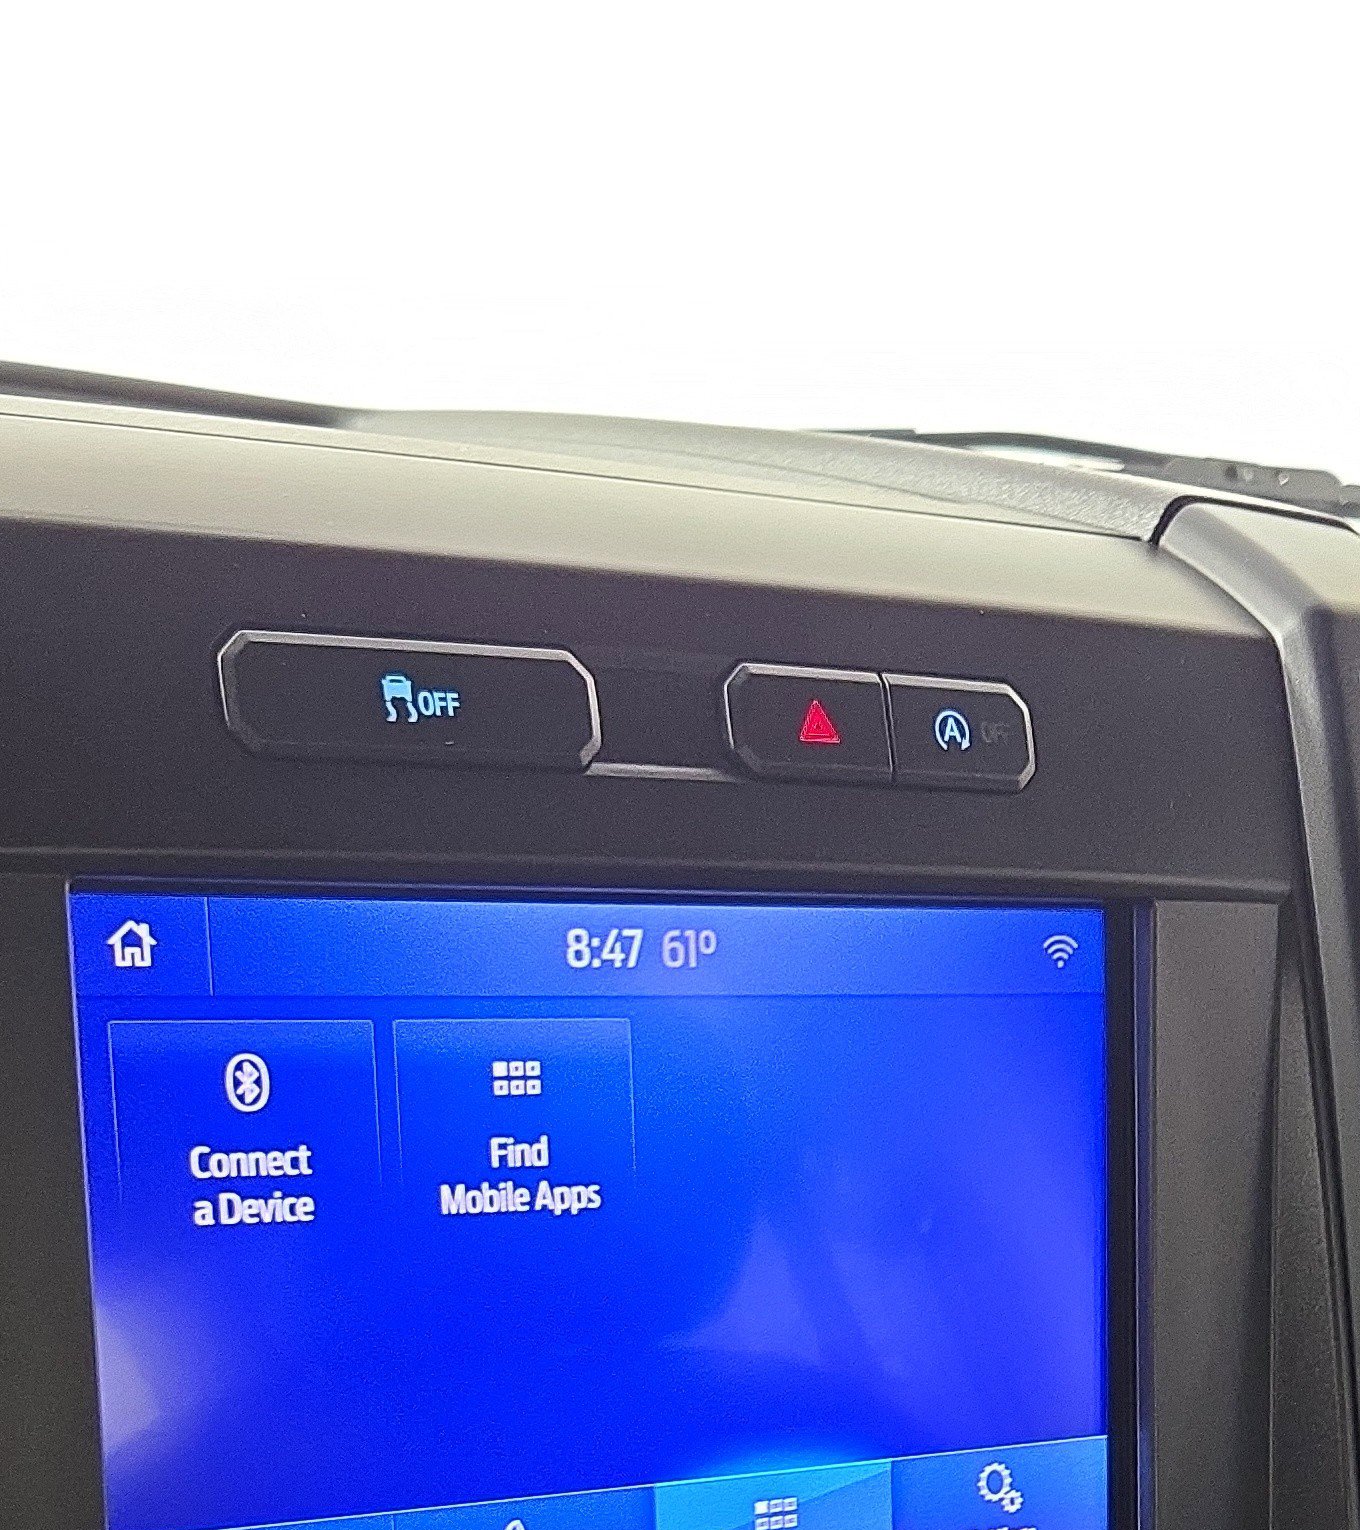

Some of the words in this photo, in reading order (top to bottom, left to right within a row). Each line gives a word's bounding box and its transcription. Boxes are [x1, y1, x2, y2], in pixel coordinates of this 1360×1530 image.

[417, 690, 461, 718] OFF
[566, 927, 643, 968] 8:47
[189, 1144, 312, 1180] Connect
[490, 1134, 549, 1169] Find
[193, 1201, 215, 1226] a
[219, 1190, 314, 1226] Device
[440, 1180, 529, 1216] Mobile
[534, 1180, 602, 1217] Apps
